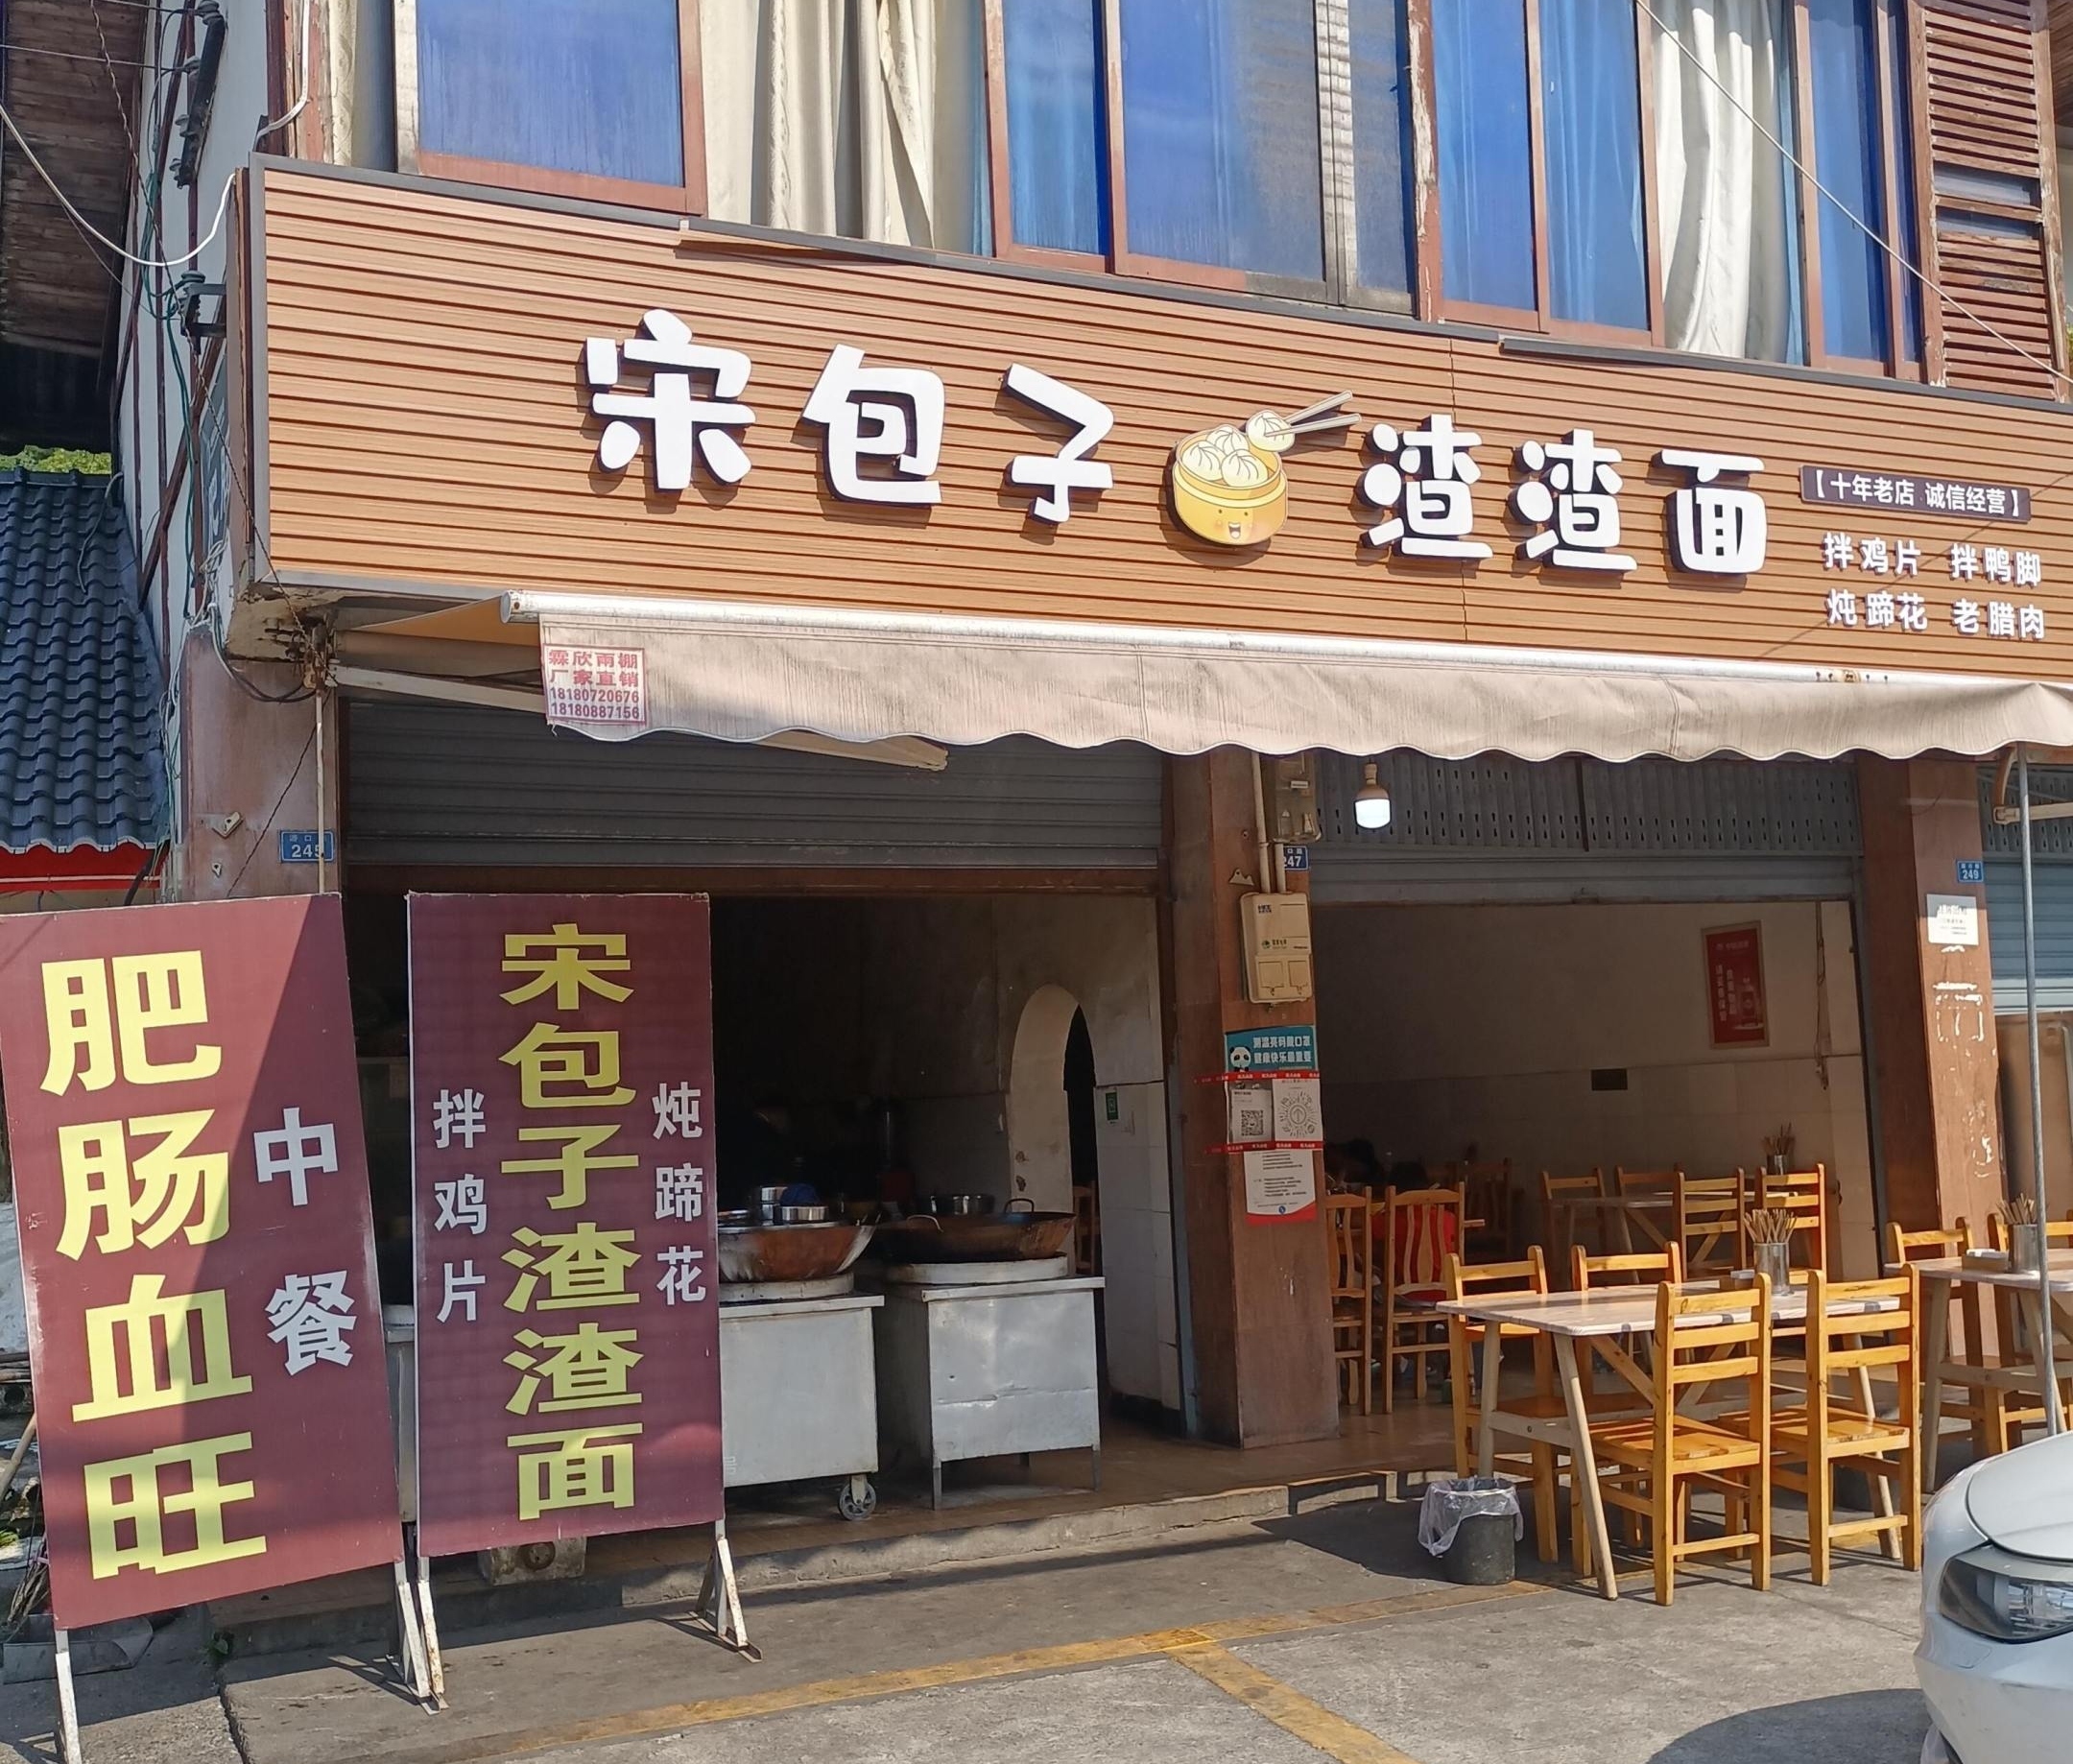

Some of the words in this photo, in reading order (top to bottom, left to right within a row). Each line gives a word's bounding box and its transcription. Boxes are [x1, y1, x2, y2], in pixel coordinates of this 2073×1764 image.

[584, 308, 1114, 523] 宋包子
[1361, 414, 1767, 574] 渣渣面
[1823, 532, 1921, 576] 拌鸡片
[1950, 543, 2042, 587] 拌鸭脚
[1826, 588, 1928, 631] 炖蹄花
[1953, 598, 2045, 639] 老腊肉
[550, 669, 639, 687] 厂家直销
[550, 686, 639, 703] 18180720676
[1962, 869, 1979, 880] 249
[39, 950, 267, 1580] 肥肠血旺
[253, 1108, 358, 1376] 中餐
[432, 1087, 488, 1323] 拌鸡片
[498, 922, 644, 1520] 宋包子渣渣面
[652, 1082, 706, 1306] 炖蹄花
